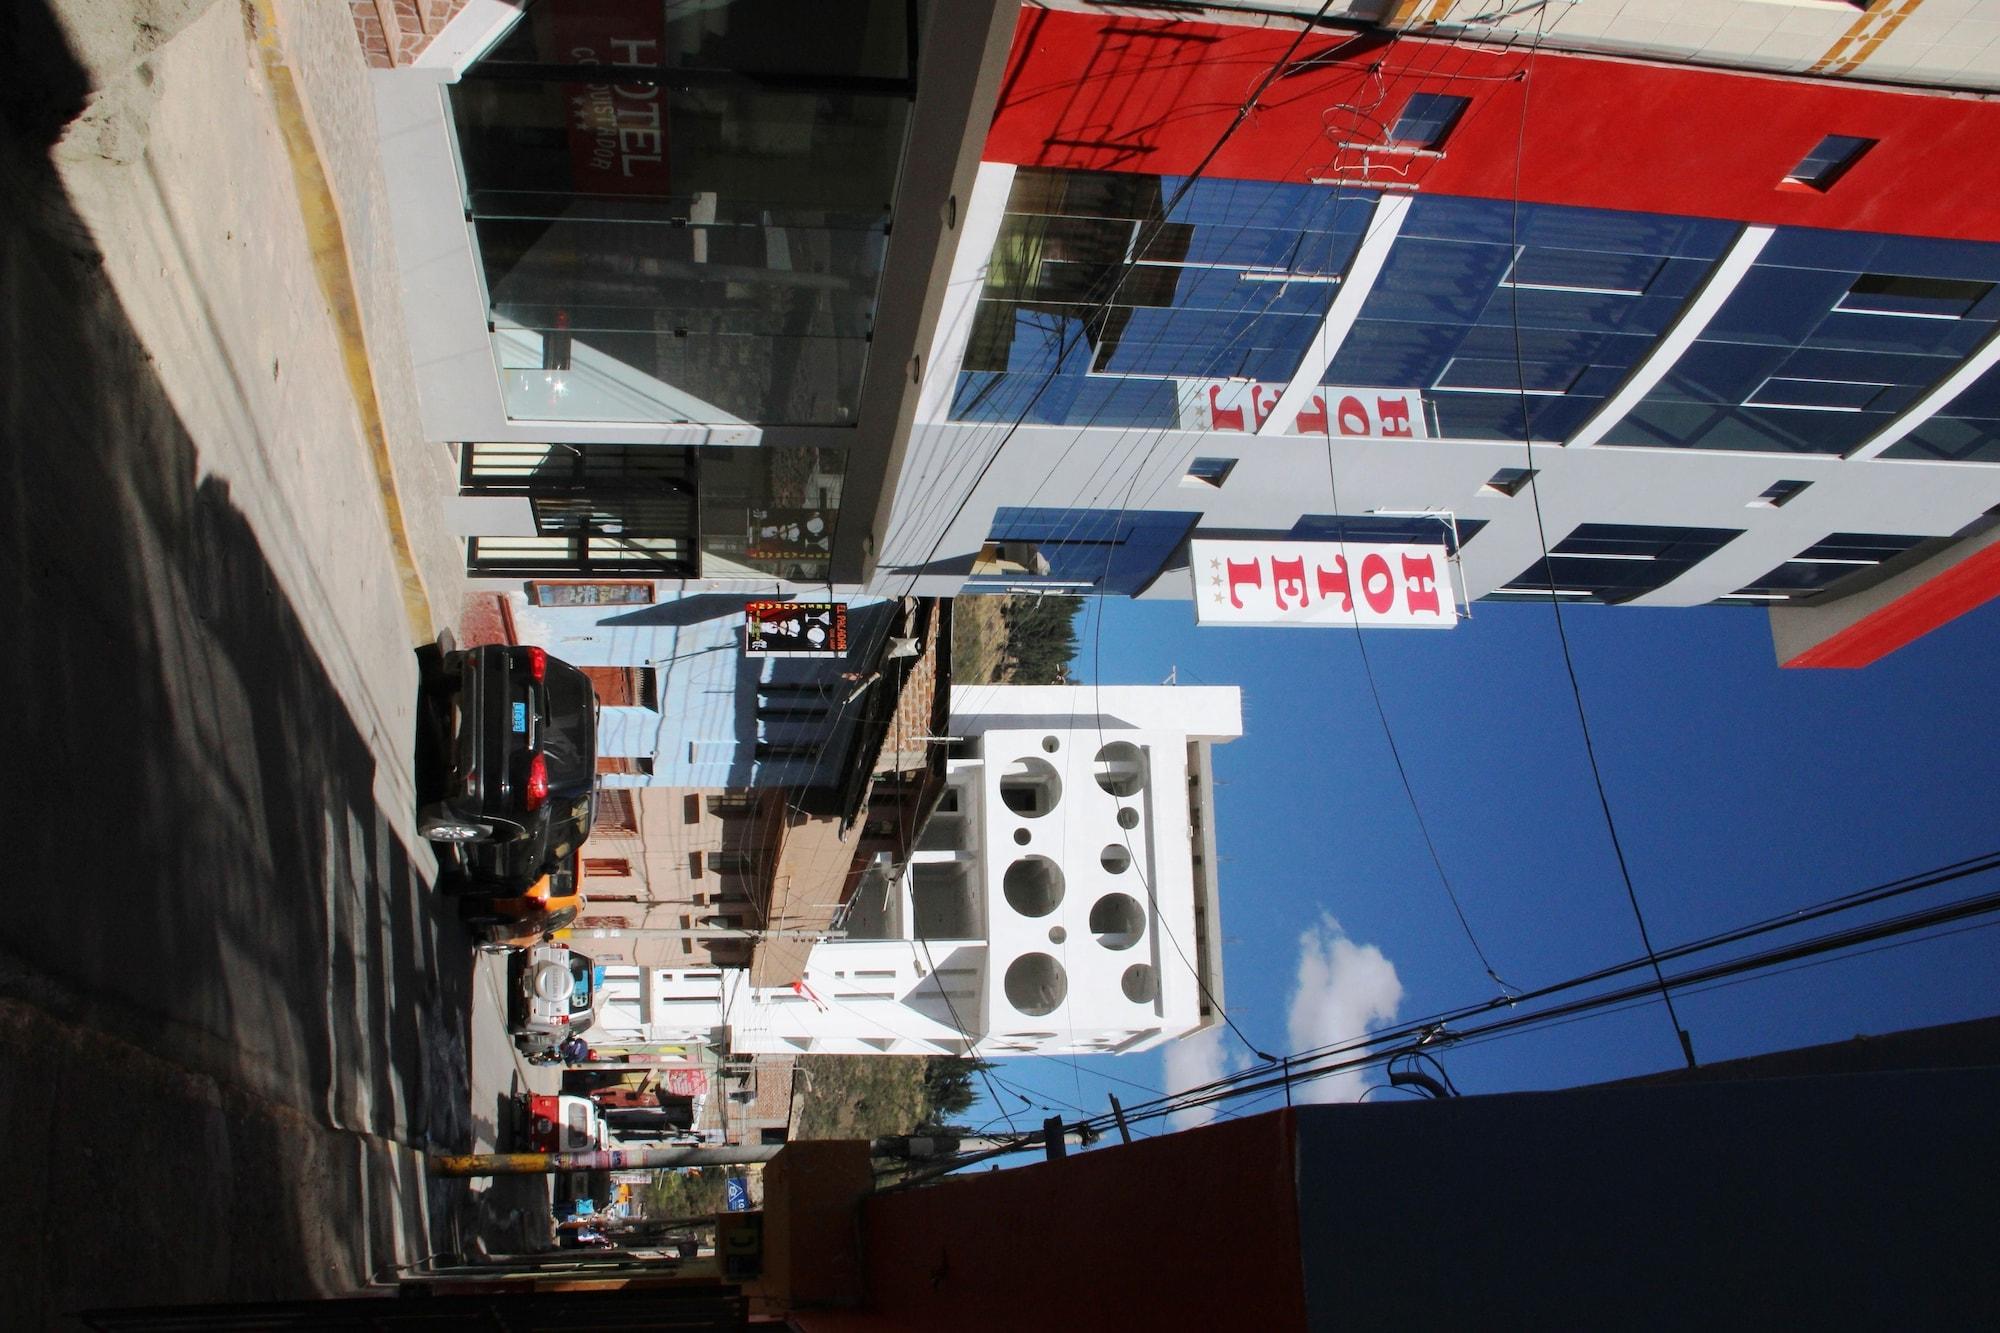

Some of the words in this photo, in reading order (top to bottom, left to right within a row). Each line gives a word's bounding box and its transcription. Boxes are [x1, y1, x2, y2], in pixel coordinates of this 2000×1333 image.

[571, 48, 618, 170] COQUISTADOR
[837, 605, 846, 613] EL
[1227, 553, 1440, 616] HOTEL
[837, 615, 847, 650] PALADAR
